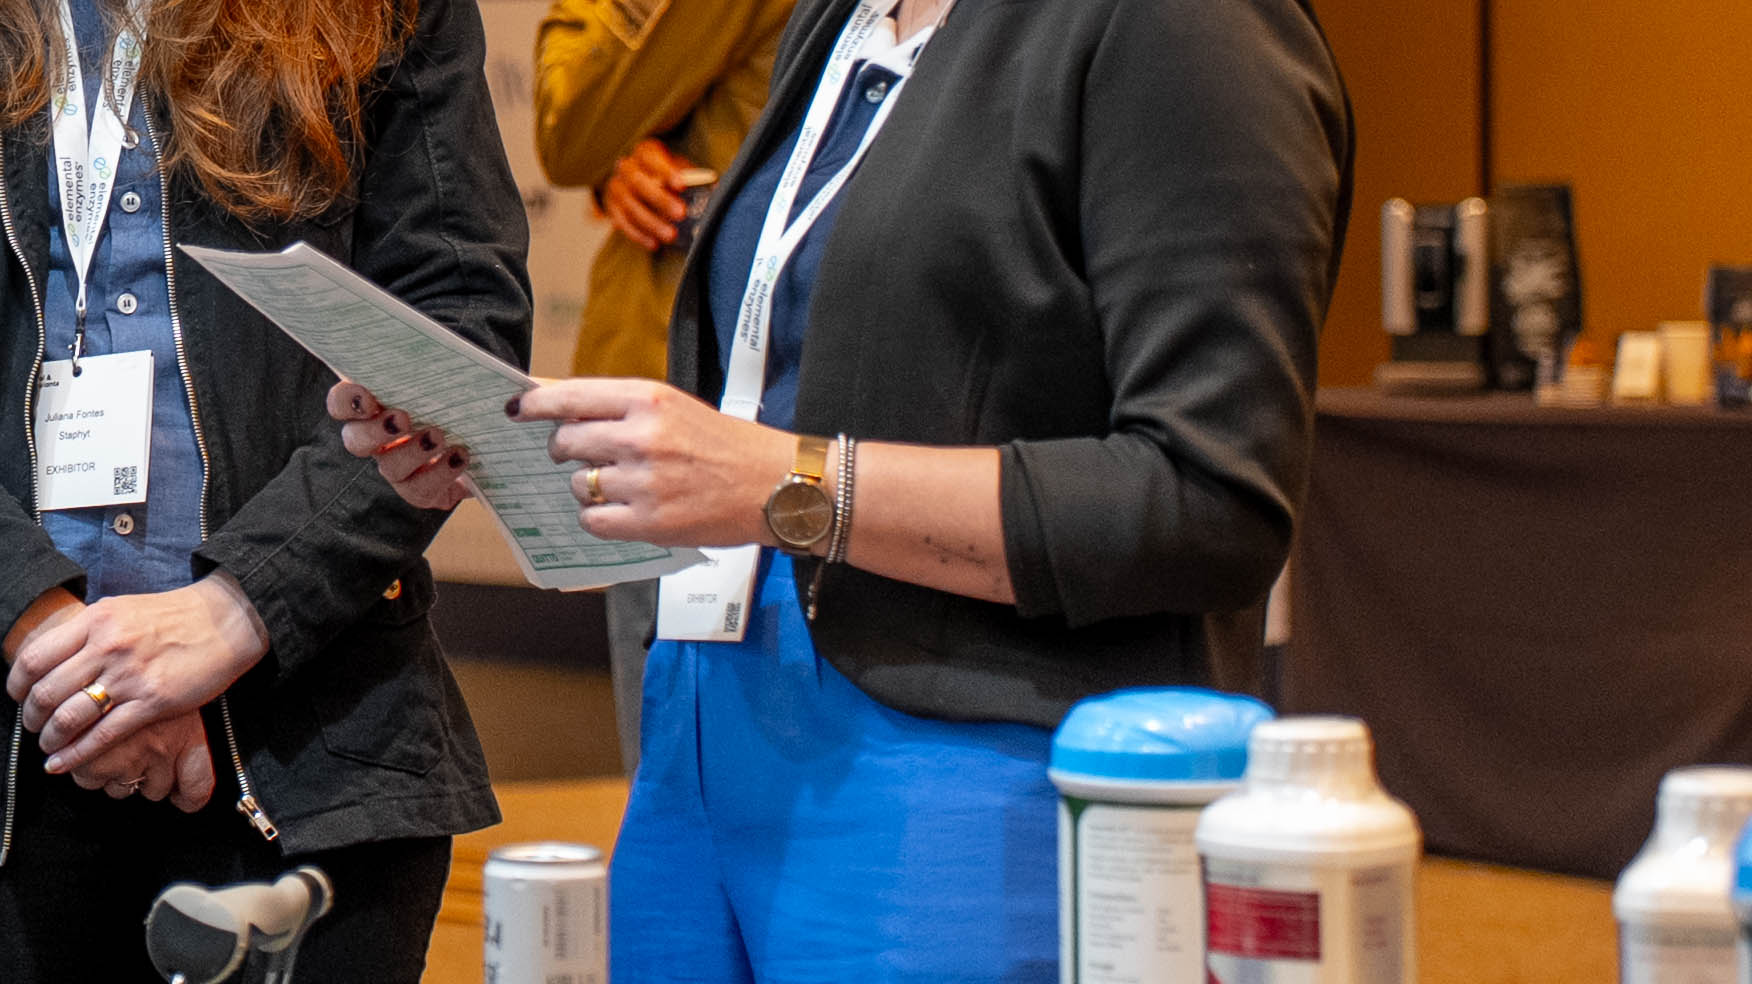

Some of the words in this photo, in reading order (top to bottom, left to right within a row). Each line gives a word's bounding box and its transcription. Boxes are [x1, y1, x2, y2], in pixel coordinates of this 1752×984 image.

[59, 156, 74, 221] elemental
[749, 283, 768, 352] elemental
[44, 412, 73, 423] Juliana
[59, 430, 90, 441] Staphyt
[46, 462, 96, 475] EXHIBITOR
